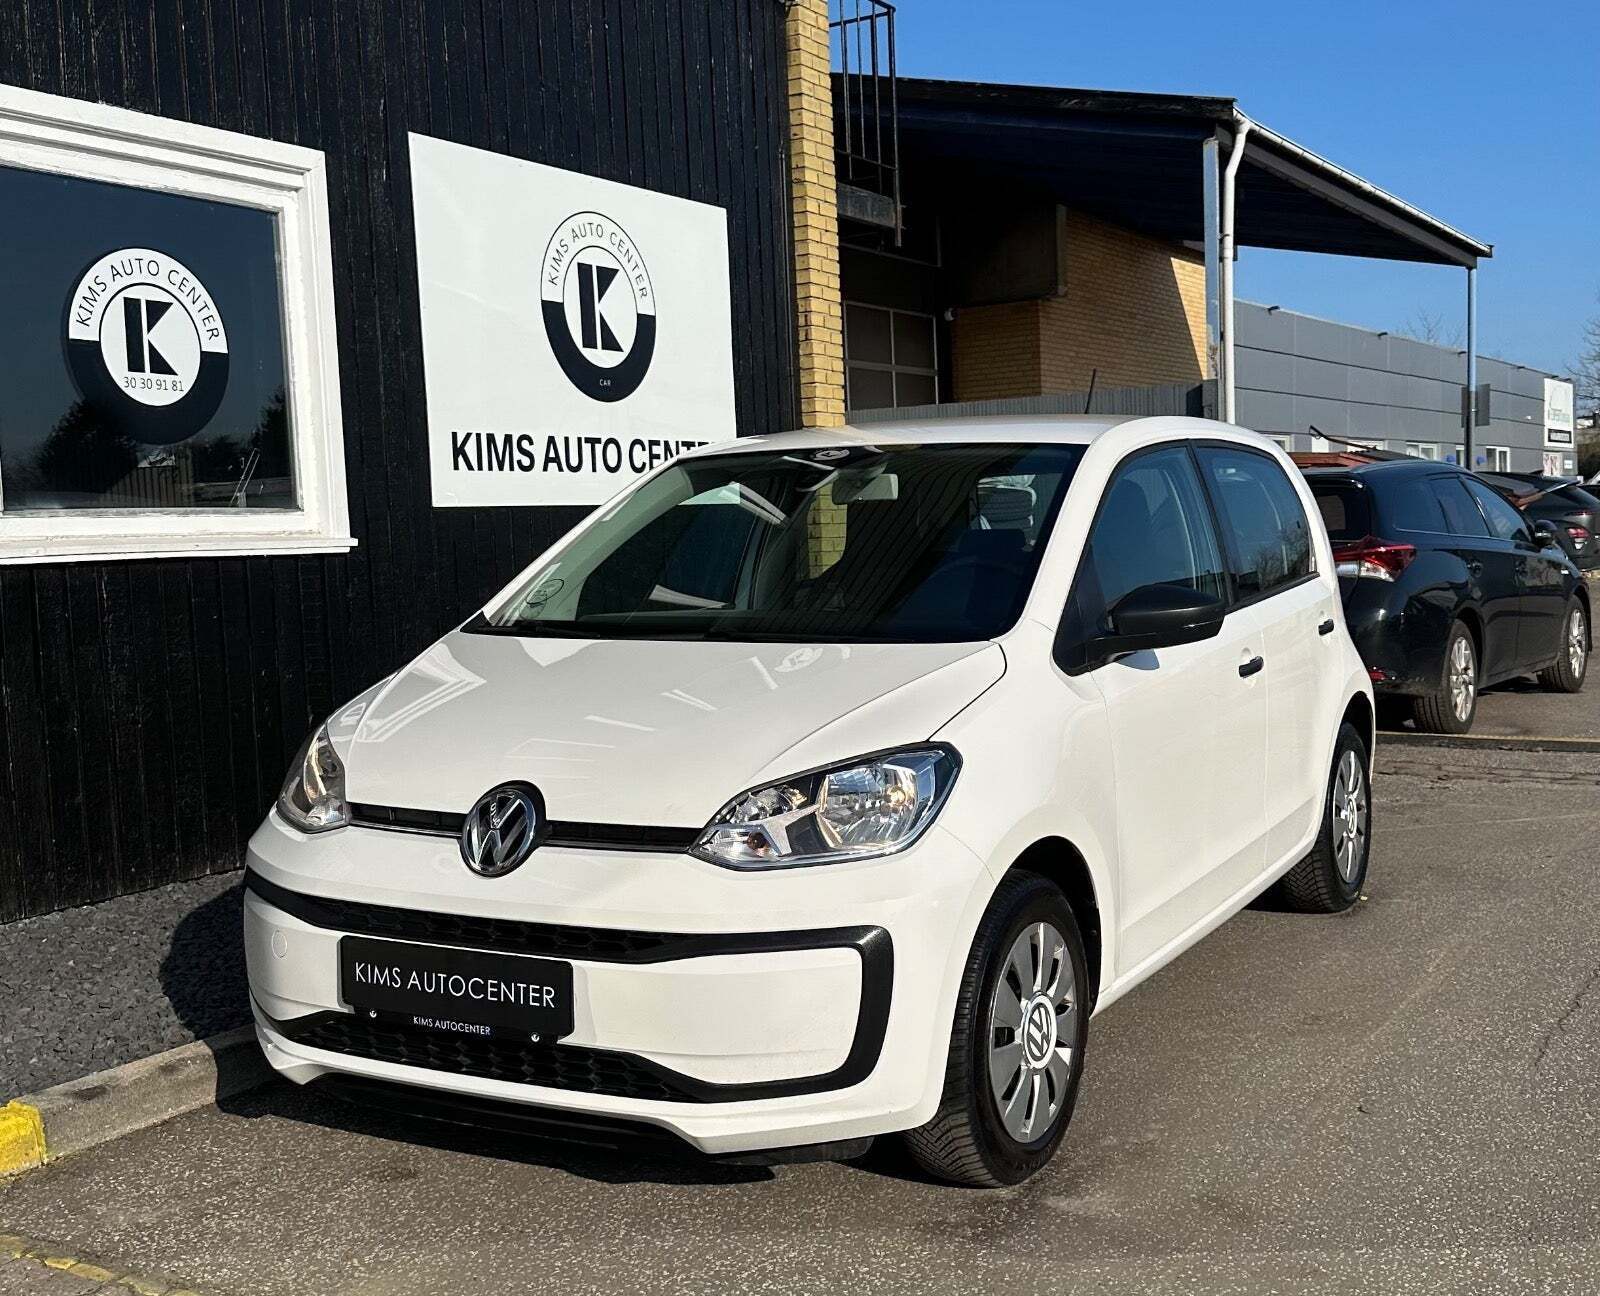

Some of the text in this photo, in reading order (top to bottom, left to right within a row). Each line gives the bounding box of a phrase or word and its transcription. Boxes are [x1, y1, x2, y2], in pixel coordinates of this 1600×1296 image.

[548, 222, 648, 299] KIMS AUTO CENTER
[75, 258, 220, 341] KIMS AUTO CENTER
[577, 262, 624, 353] K
[122, 296, 179, 376] K
[123, 376, 184, 392] 30 30 91 81
[451, 431, 714, 474] KIMS AUTO CENT
[355, 961, 555, 1008] KIMS AUTOCENTER
[413, 1015, 491, 1036] KIMS AUTOCENTER
